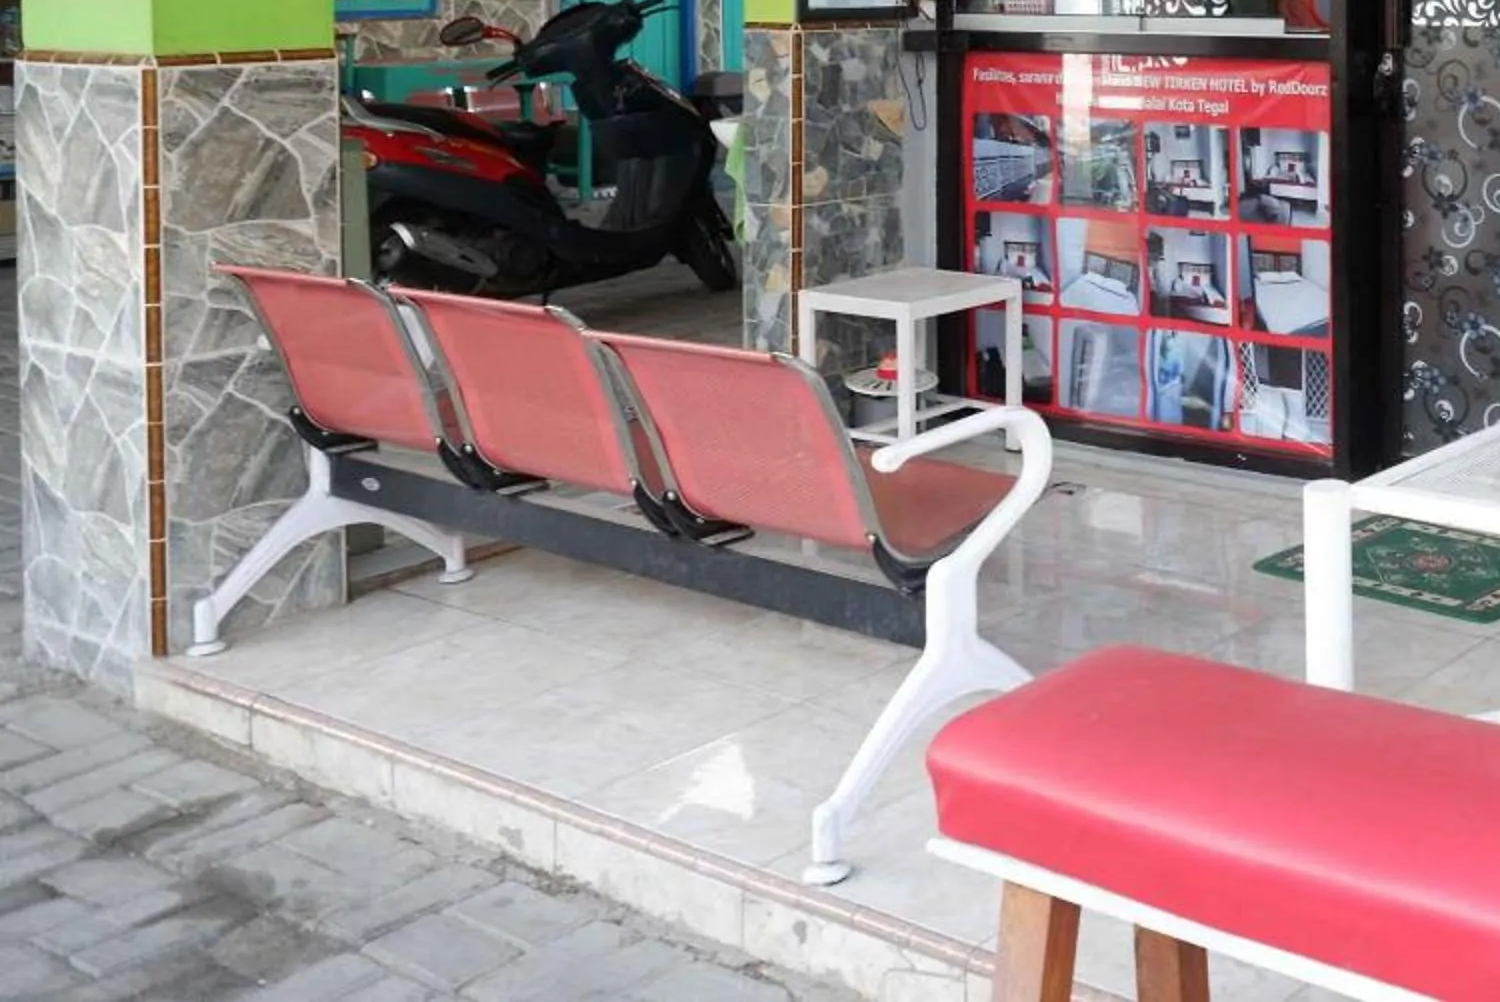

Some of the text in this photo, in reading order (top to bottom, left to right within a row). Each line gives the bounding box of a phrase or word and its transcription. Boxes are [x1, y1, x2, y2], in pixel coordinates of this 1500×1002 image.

[1209, 76, 1248, 93] HOTEL
[1251, 78, 1266, 96] by
[1269, 79, 1328, 97] RedDoorz
[1169, 97, 1195, 112] Kota
[1198, 99, 1229, 116] Tegal
